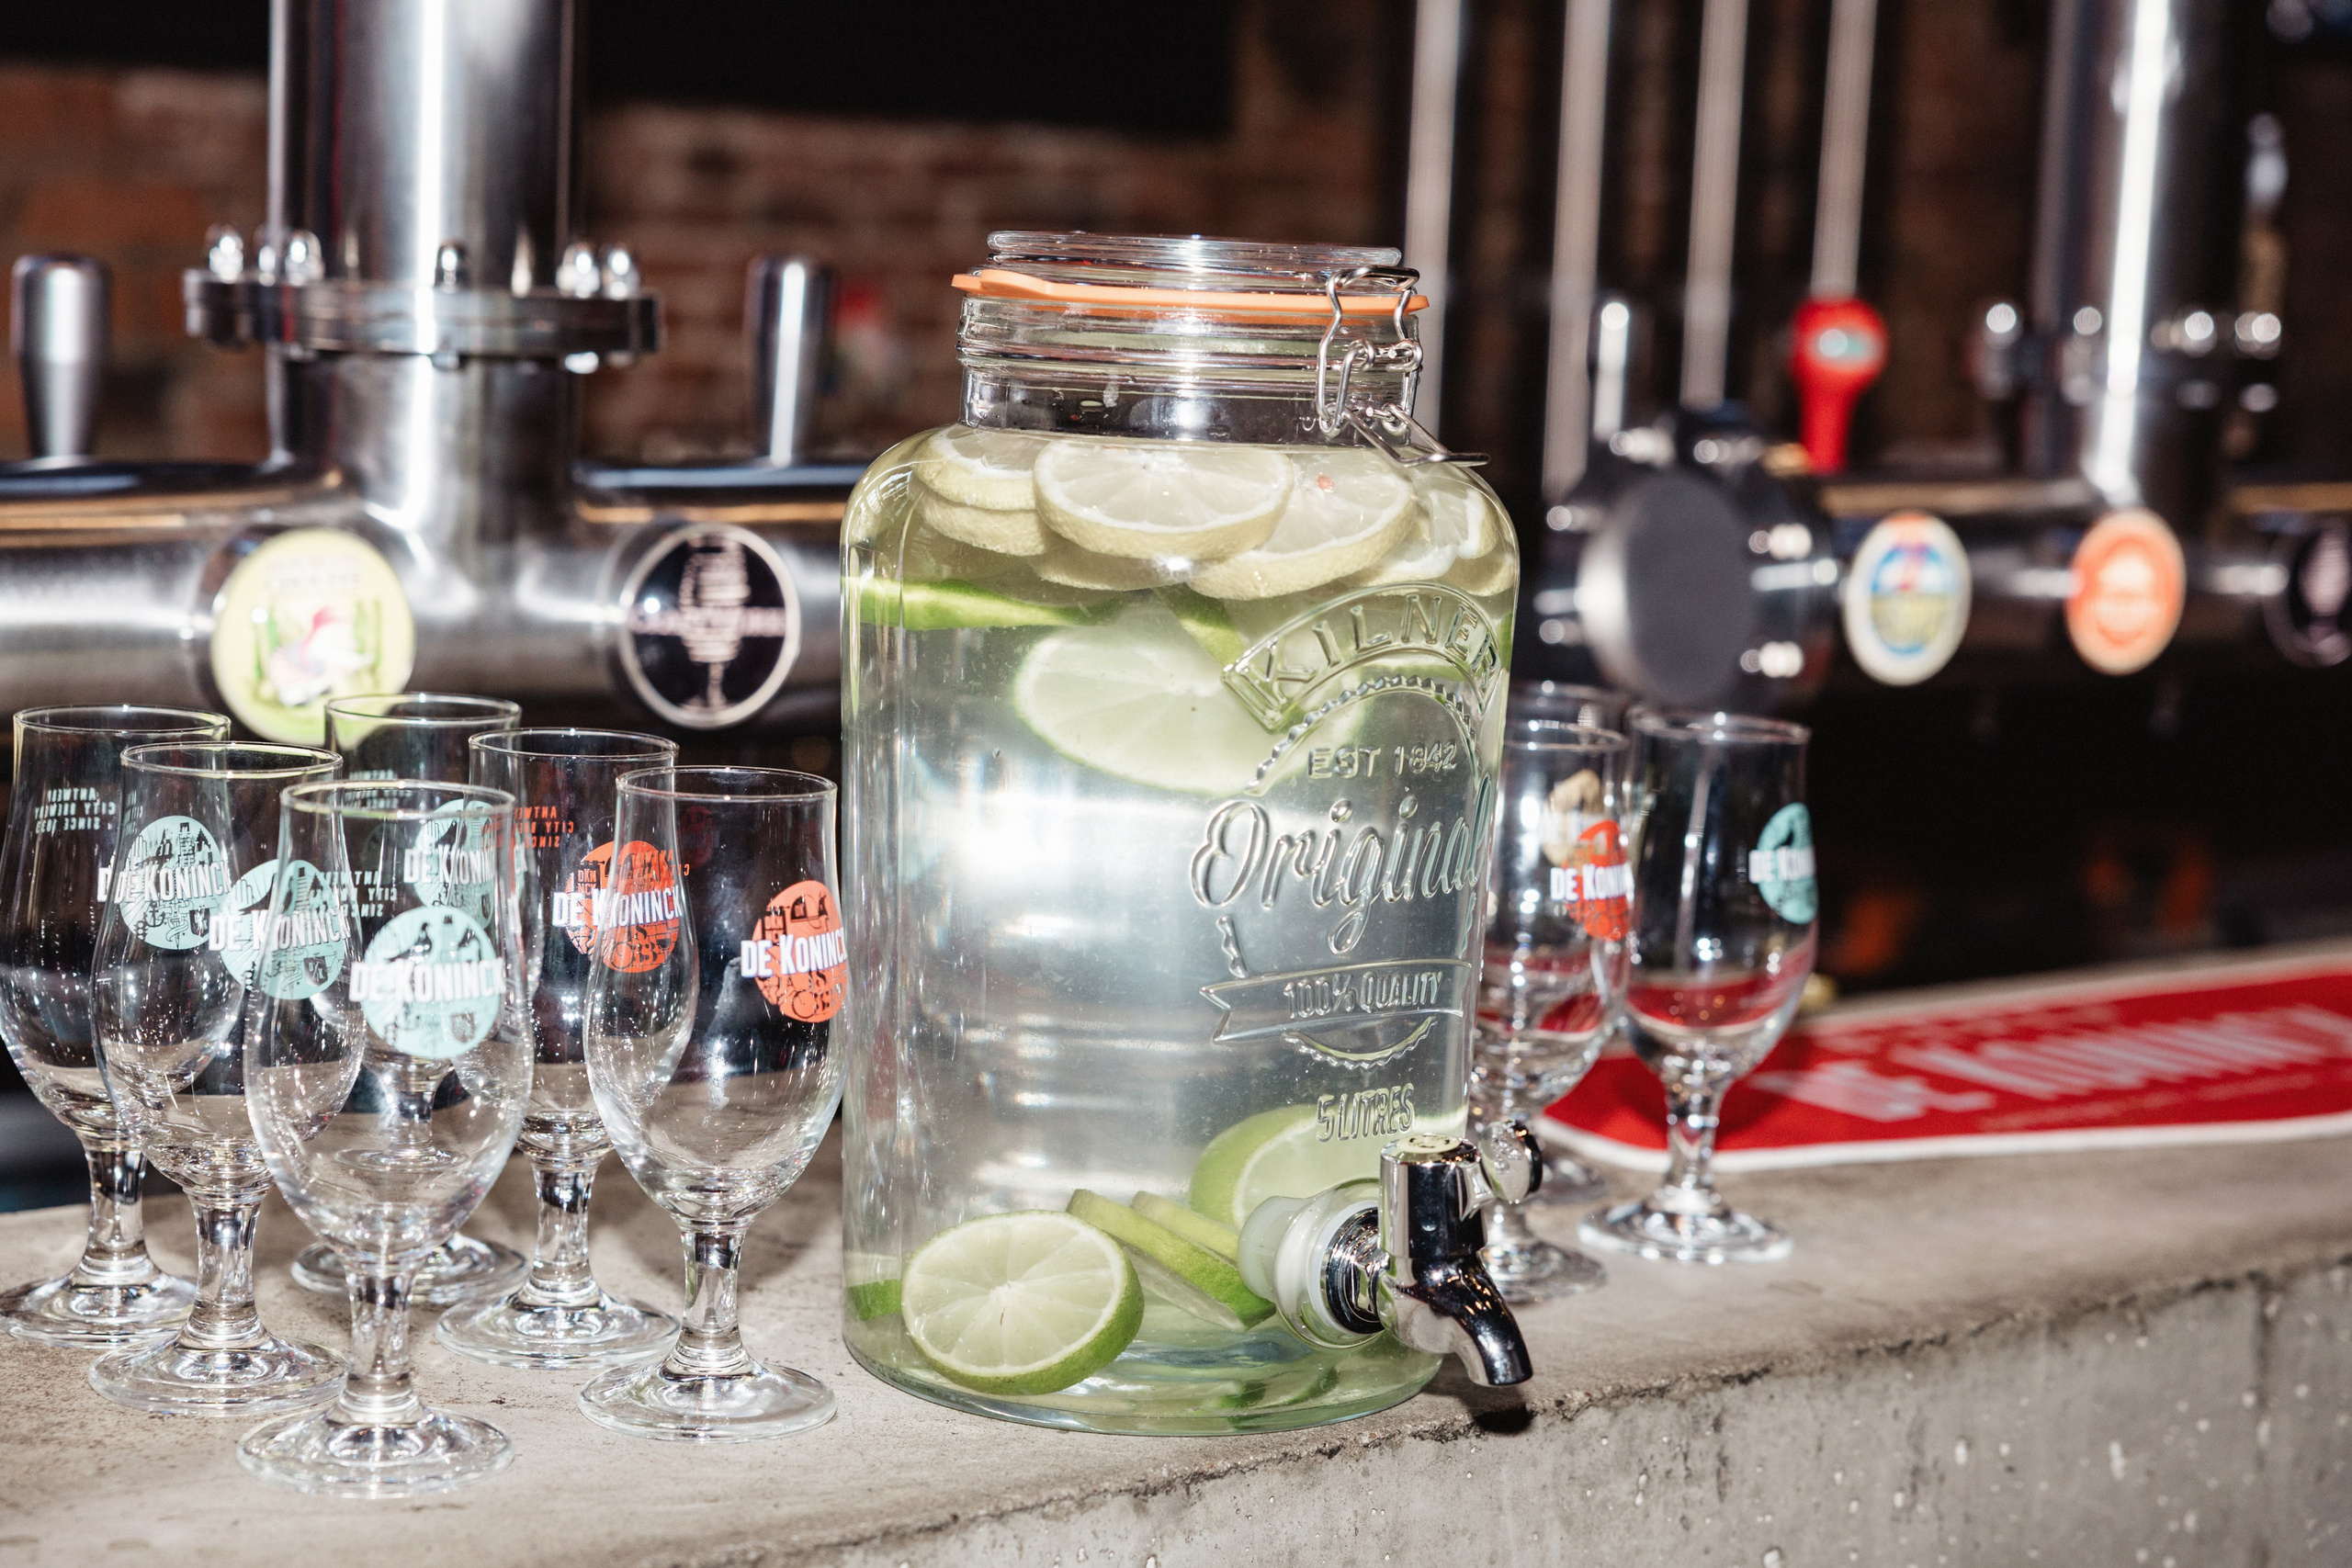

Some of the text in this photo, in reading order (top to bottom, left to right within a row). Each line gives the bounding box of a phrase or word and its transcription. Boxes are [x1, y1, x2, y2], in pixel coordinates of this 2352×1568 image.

[1236, 593, 1498, 706] KILNER
[1308, 747, 1382, 779] EST
[403, 848, 433, 884] DE
[1191, 773, 1493, 954] Original
[1550, 866, 1579, 901] DE
[552, 891, 585, 928] DE
[209, 914, 243, 952] DE
[741, 939, 774, 977] DE
[348, 956, 505, 1003] DE KONINCK
[1283, 972, 1357, 1020] 100%
